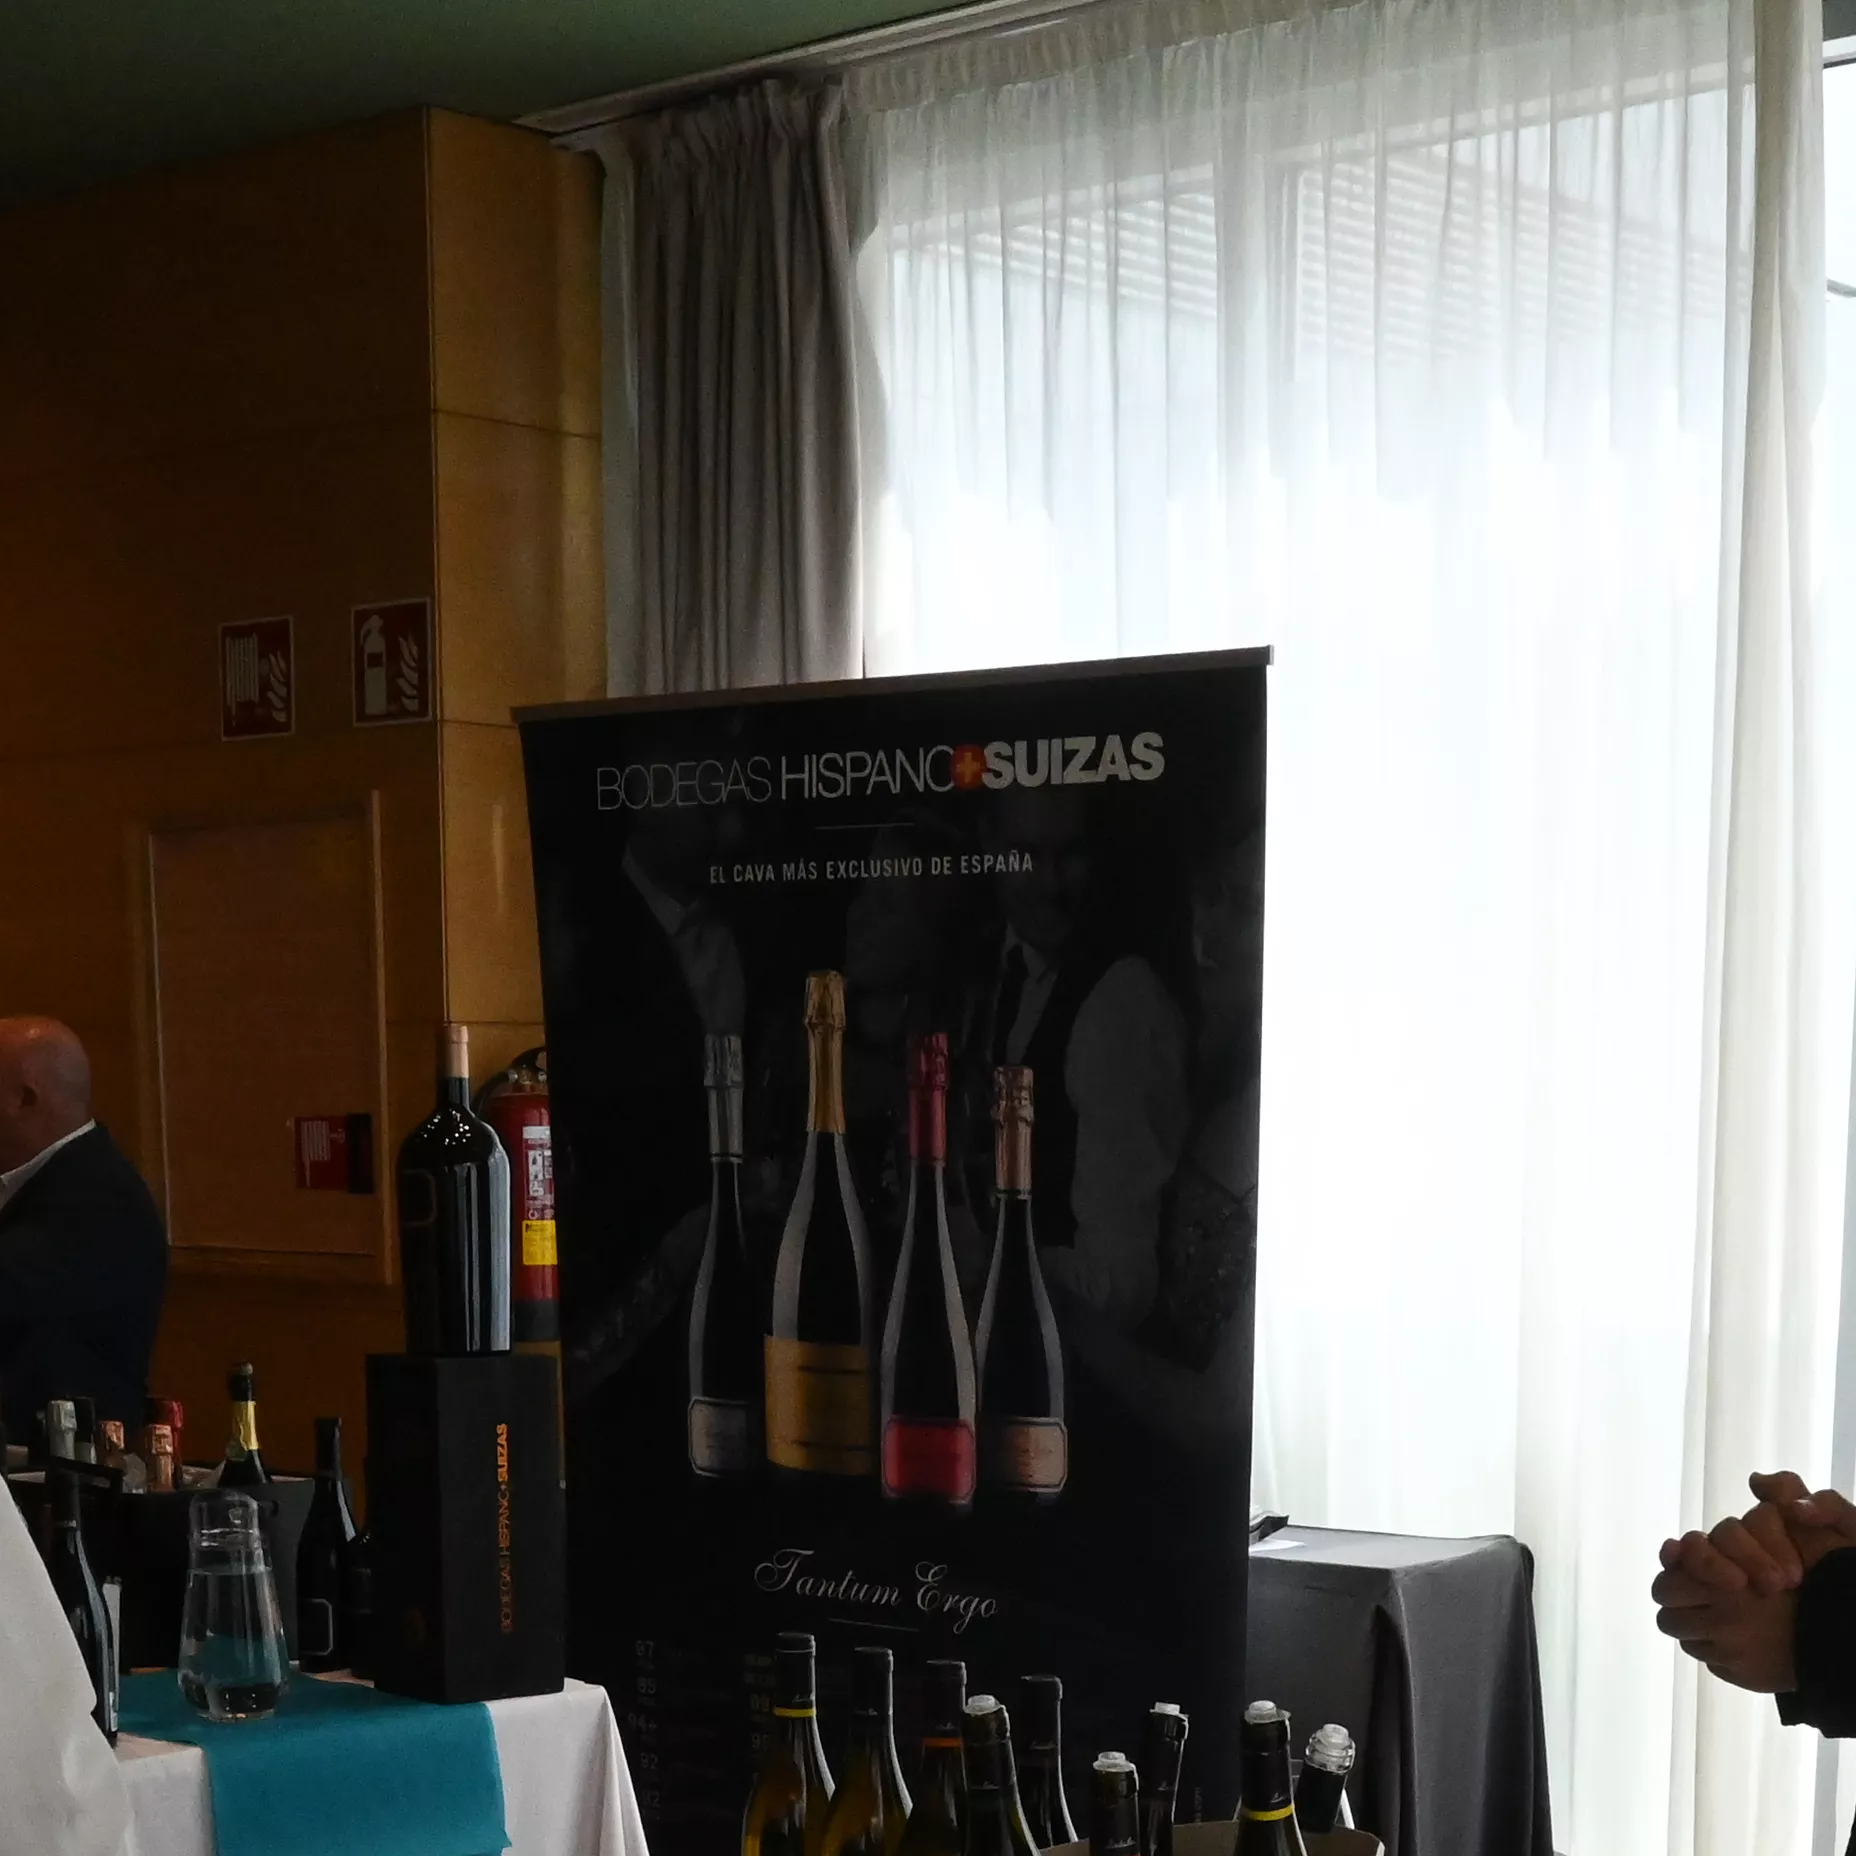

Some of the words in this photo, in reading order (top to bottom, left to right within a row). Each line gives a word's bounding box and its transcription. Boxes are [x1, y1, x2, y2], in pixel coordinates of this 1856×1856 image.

[597, 757, 771, 811] BODEGAS
[710, 864, 727, 885] EL
[732, 862, 777, 884] CAVA
[783, 857, 819, 881] MÁS
[826, 857, 924, 881] EXCLUSIVO
[931, 856, 952, 877] DE
[960, 850, 1034, 875] ESPAÑA
[754, 1547, 902, 1607] Tantum
[914, 1561, 998, 1635] Ergo
